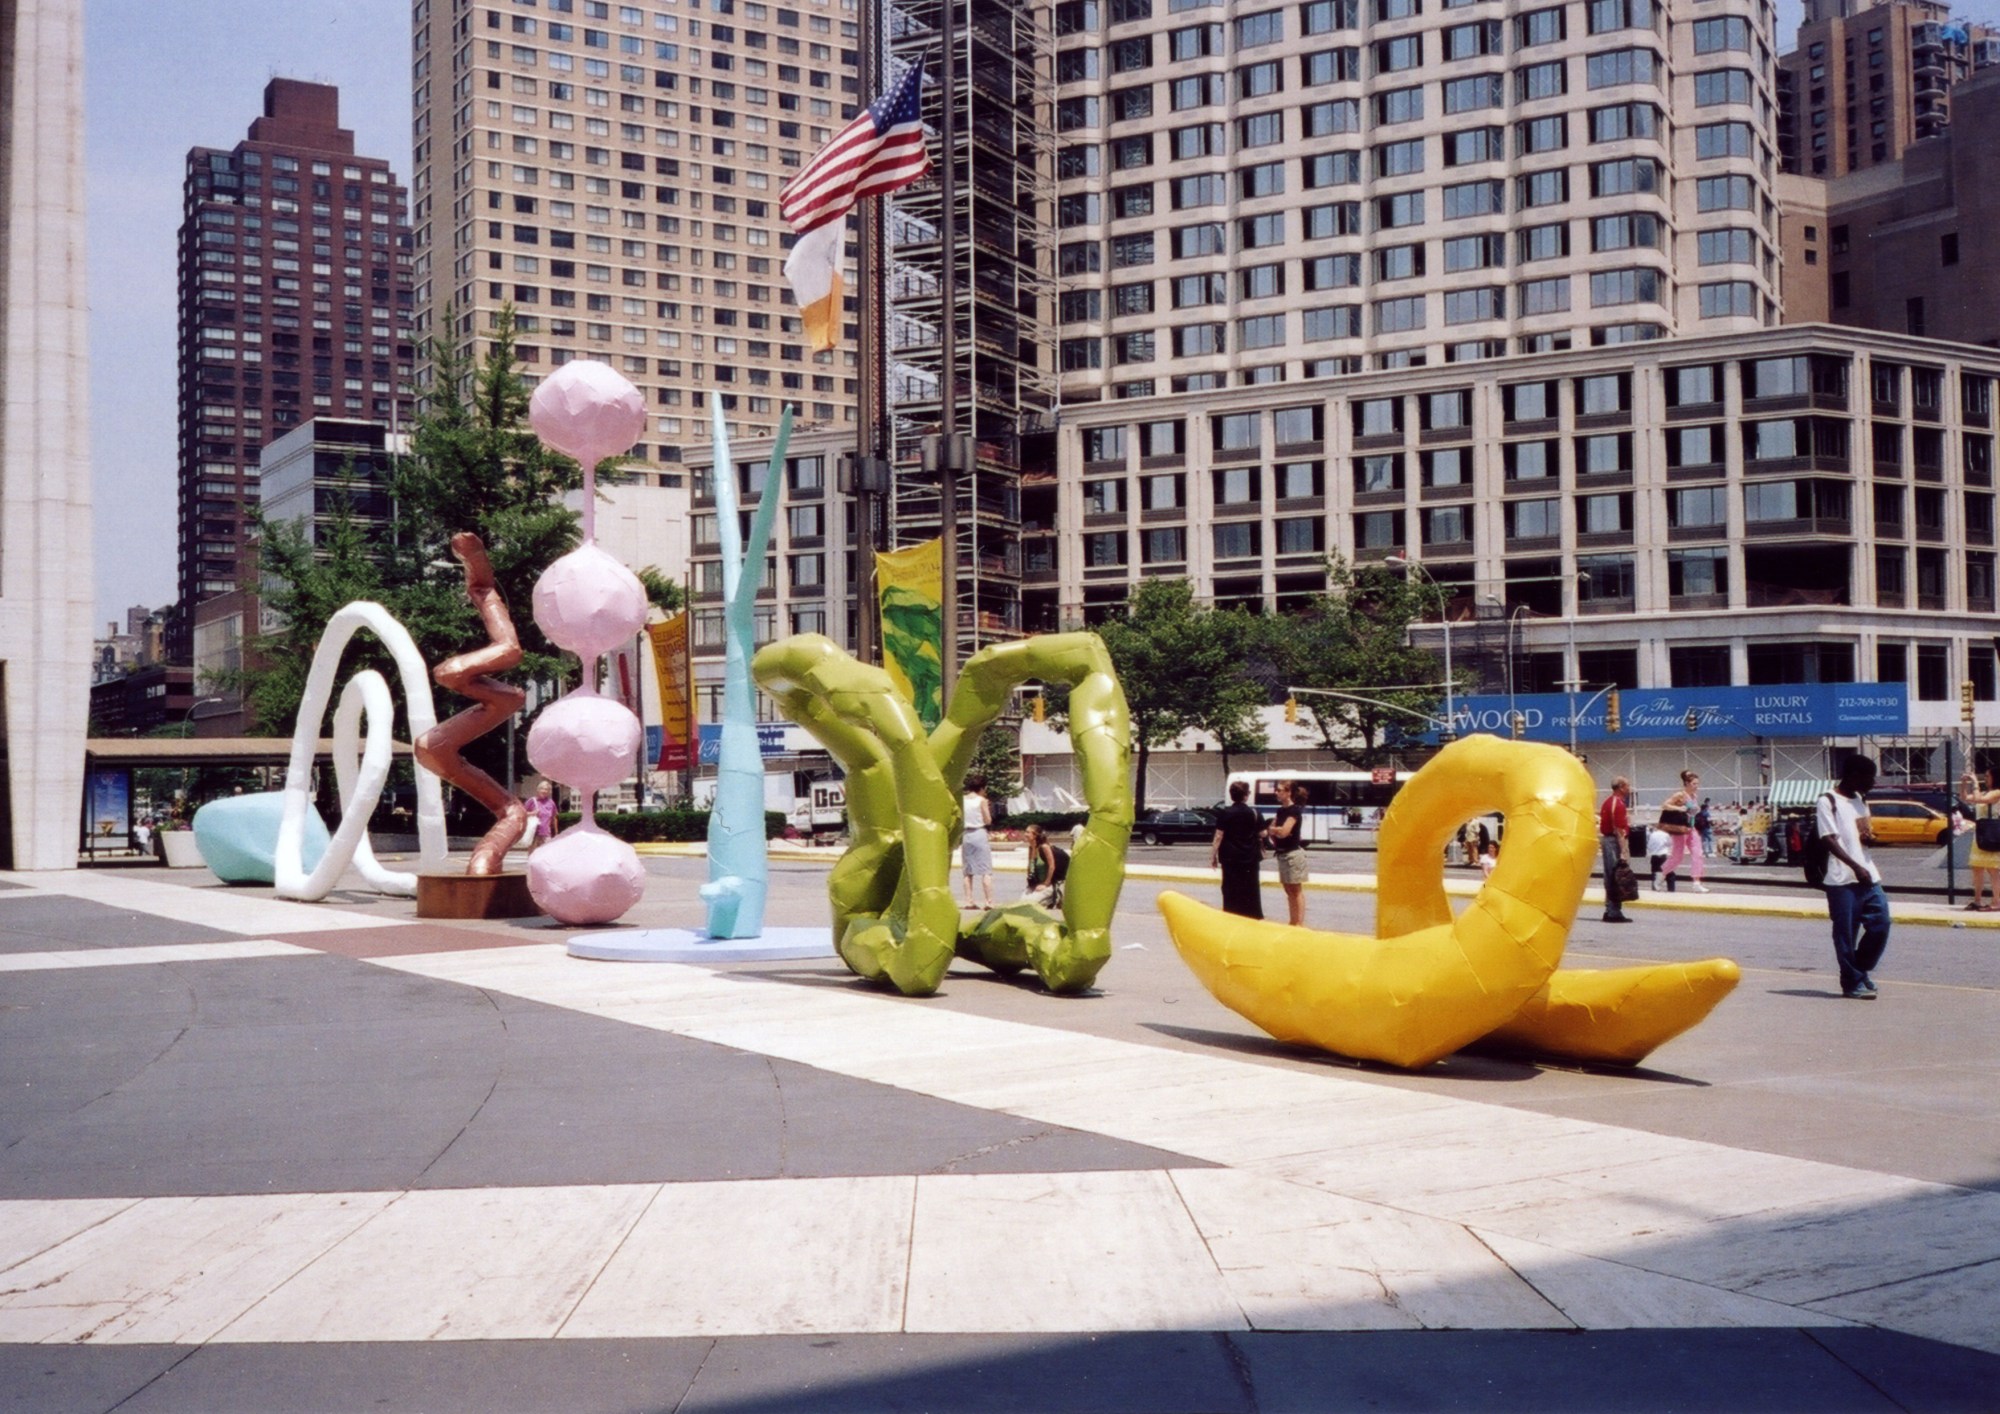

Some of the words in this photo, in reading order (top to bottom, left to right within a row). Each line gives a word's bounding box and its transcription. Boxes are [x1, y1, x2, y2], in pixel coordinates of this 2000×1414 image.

[1651, 697, 1675, 712] The
[1755, 696, 1809, 708] LUXURY
[1839, 697, 1898, 708] 212-769-1930
[1626, 704, 1689, 727] Grand
[1756, 712, 1812, 725] RENTALS
